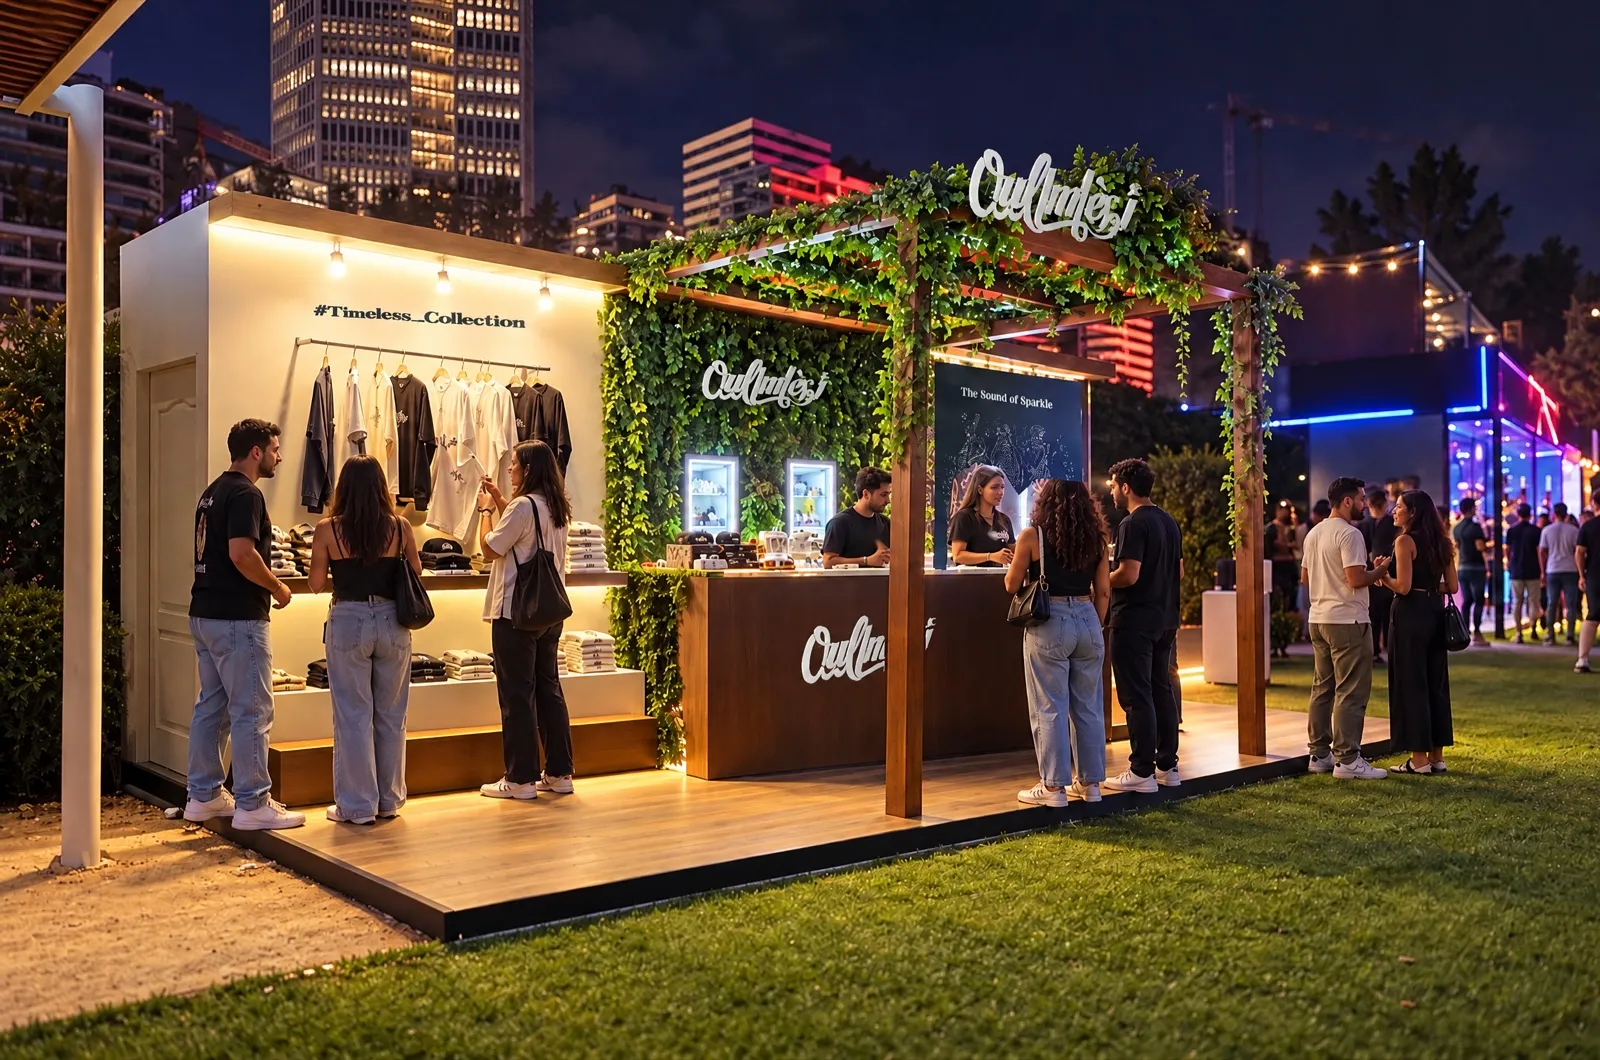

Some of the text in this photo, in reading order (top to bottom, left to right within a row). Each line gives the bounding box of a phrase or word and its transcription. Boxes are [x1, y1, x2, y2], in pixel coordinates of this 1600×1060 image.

[960, 386, 1054, 410] The Sound of Sparkle
